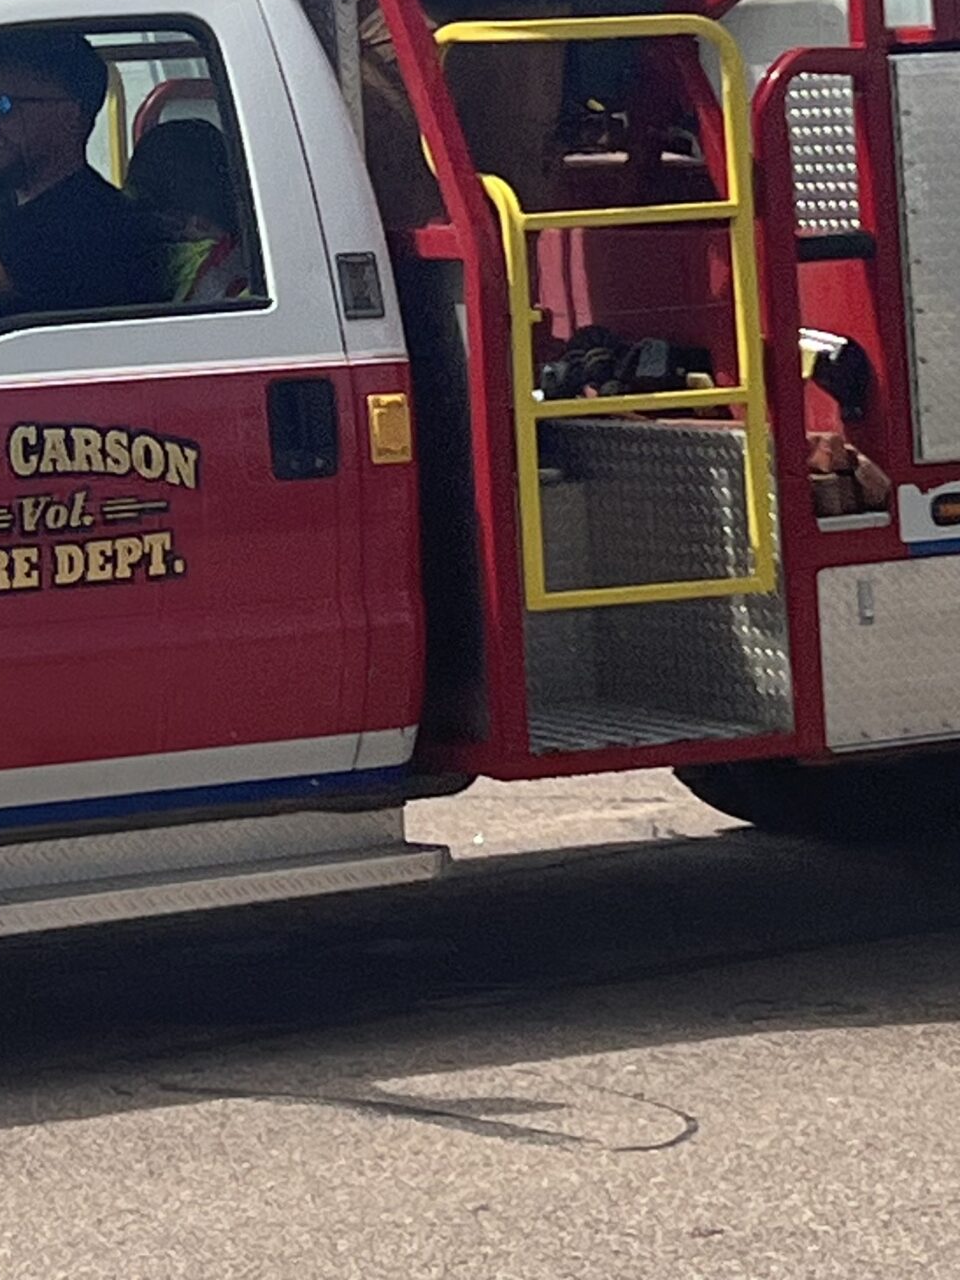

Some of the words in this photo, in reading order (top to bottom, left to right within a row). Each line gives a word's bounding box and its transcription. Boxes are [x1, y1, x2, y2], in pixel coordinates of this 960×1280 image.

[8, 423, 199, 489] CARSON
[19, 490, 94, 533] Vol.
[53, 530, 186, 587] DEPT.
